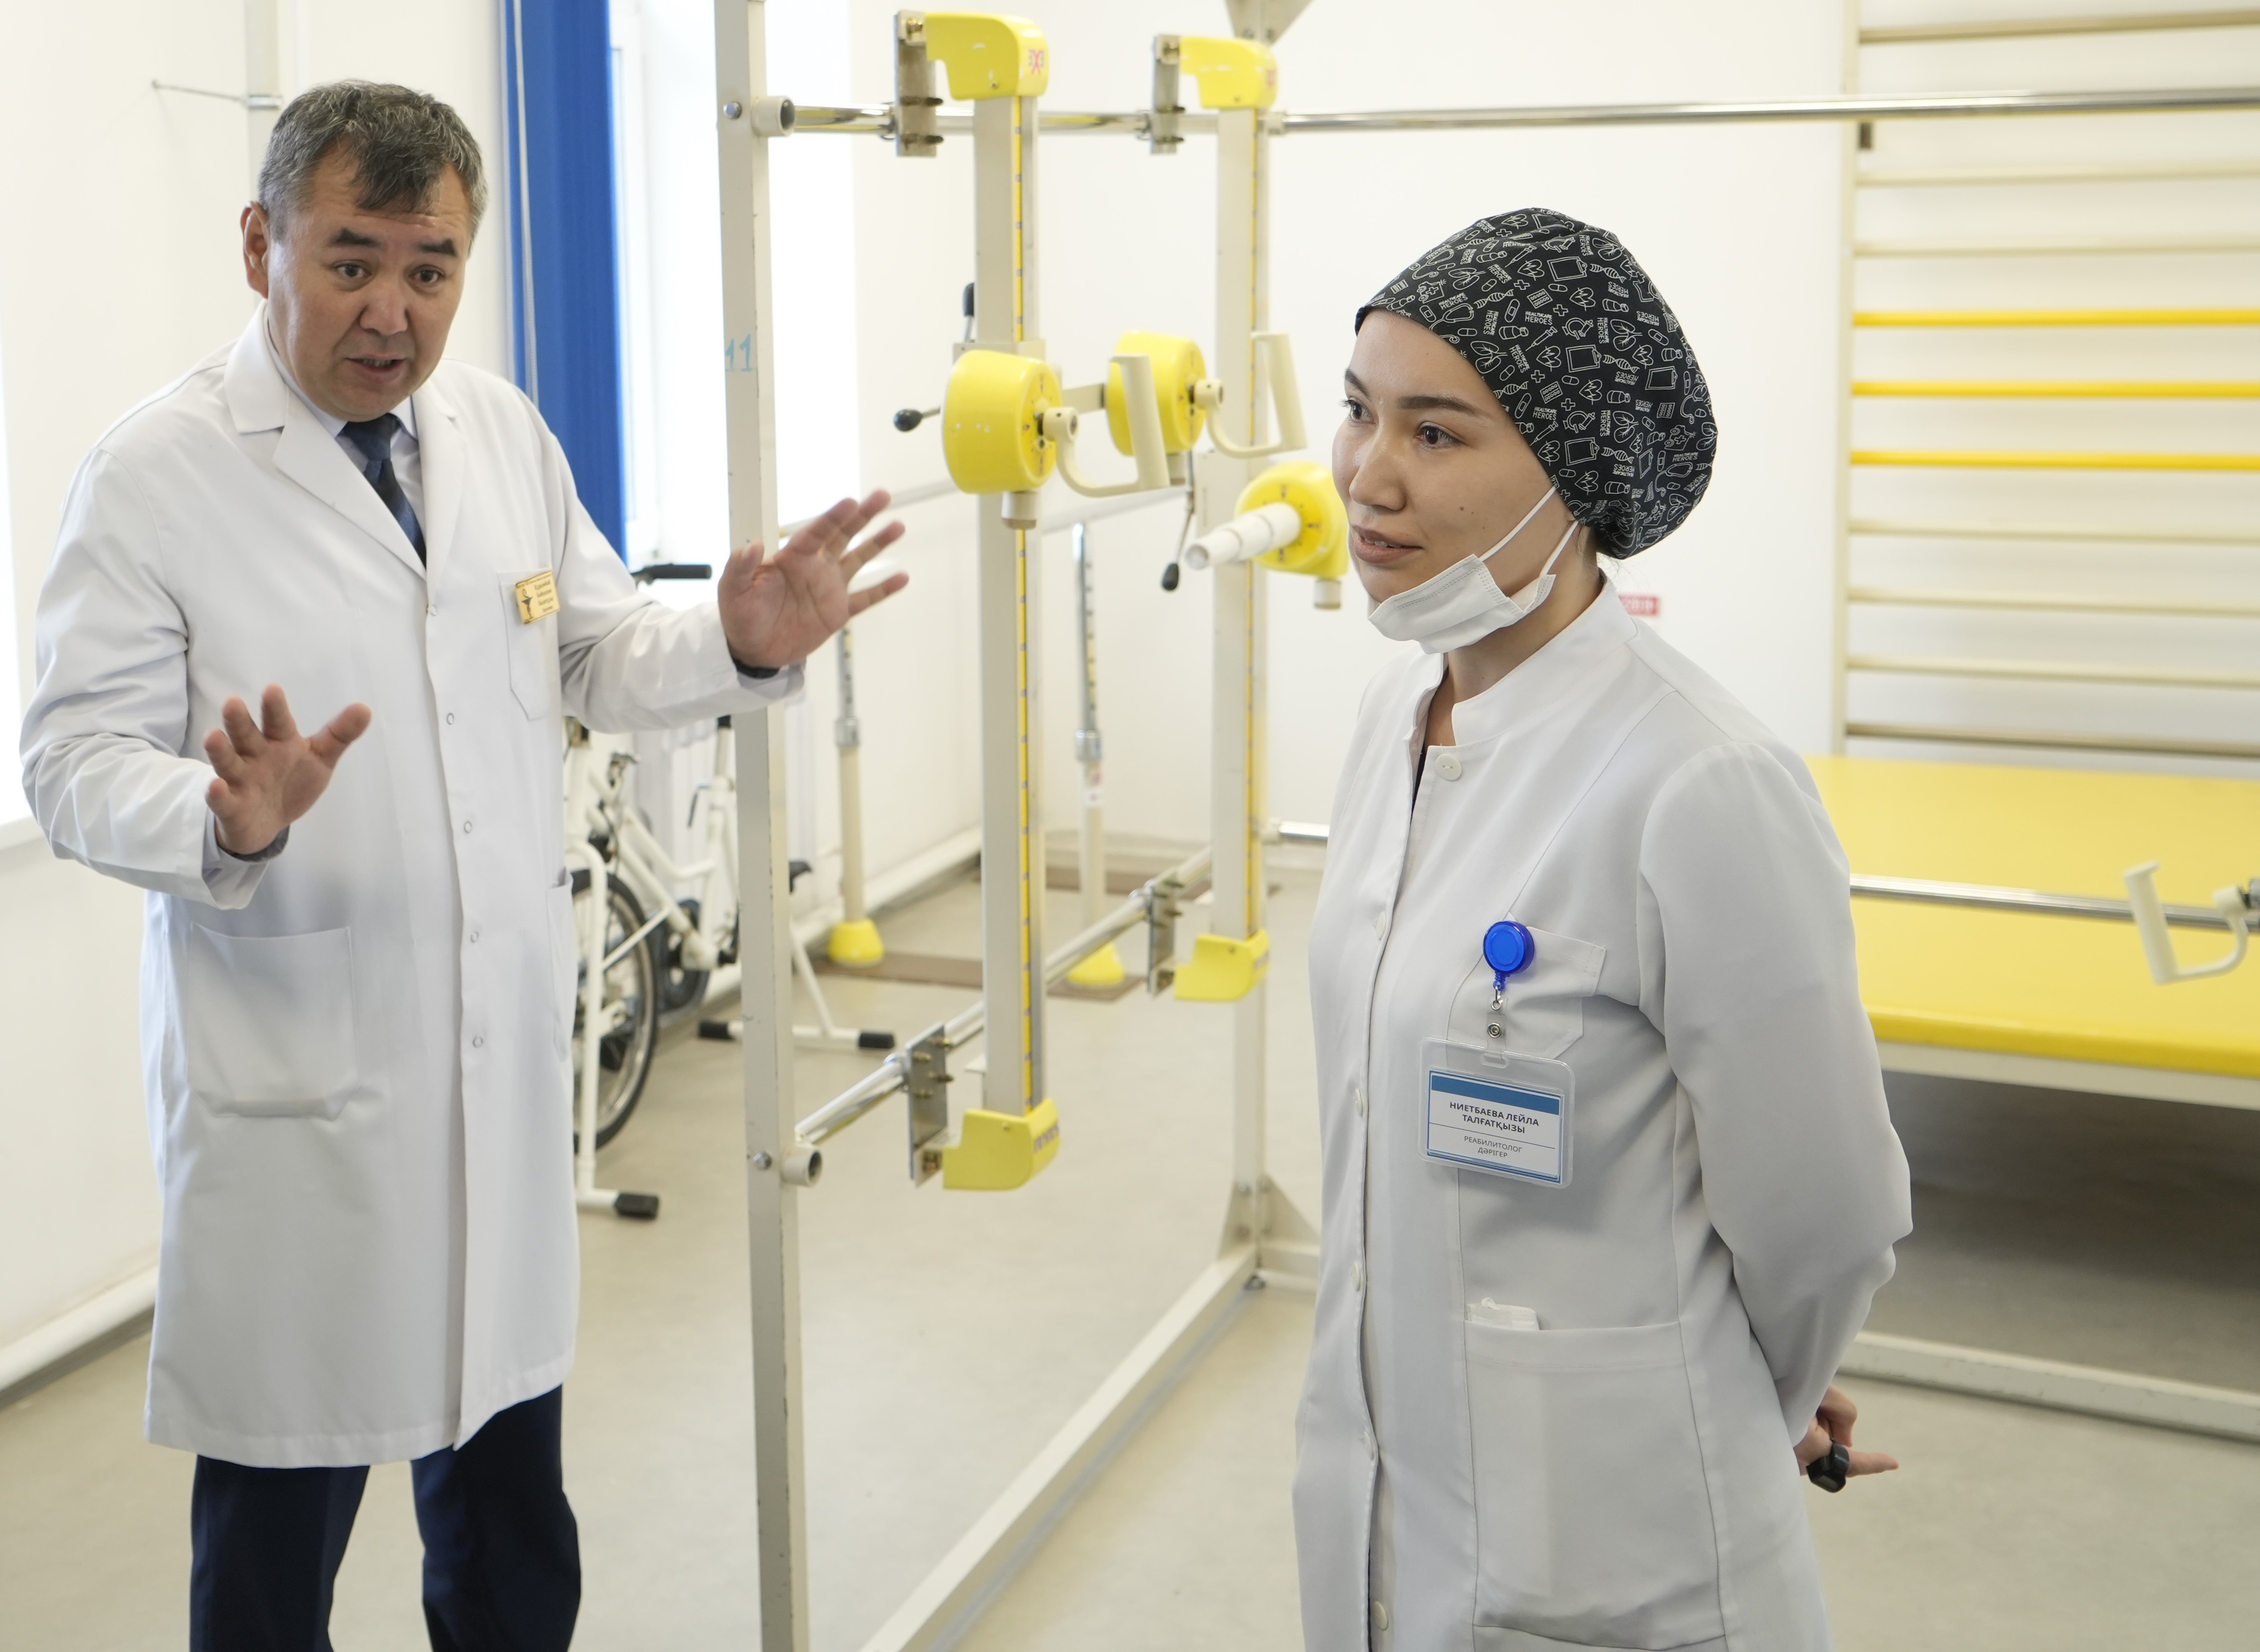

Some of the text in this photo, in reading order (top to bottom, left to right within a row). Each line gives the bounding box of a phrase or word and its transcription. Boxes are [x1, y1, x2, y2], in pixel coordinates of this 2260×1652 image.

[1579, 235, 1589, 256] HEROES
[1487, 265, 1508, 284] HEROES
[1608, 281, 1628, 294] HEROES
[1440, 295, 1468, 310] HEROES
[1483, 310, 1494, 335] HEROES
[1525, 311, 1552, 320] HEALTHCARE
[1525, 315, 1553, 325] HEROES
[1636, 311, 1659, 322] HEROES
[1597, 317, 1605, 344] HEROES
[1509, 346, 1526, 373] HEROES
[1515, 344, 1530, 371] HEALTHCARE
[1615, 371, 1639, 382] HEROES
[1532, 411, 1557, 421] HEROES
[1613, 464, 1636, 473] HEROES
[1450, 1101, 1539, 1127] НИЕТБАЕВА ЛЕЙЛА
[1462, 1114, 1525, 1133] ТАЛҒАТҚЫЗЫ
[1464, 1135, 1522, 1153] РЕАБИЛИТОЛОГ
[1477, 1147, 1508, 1158] ДӘРІГЕР
